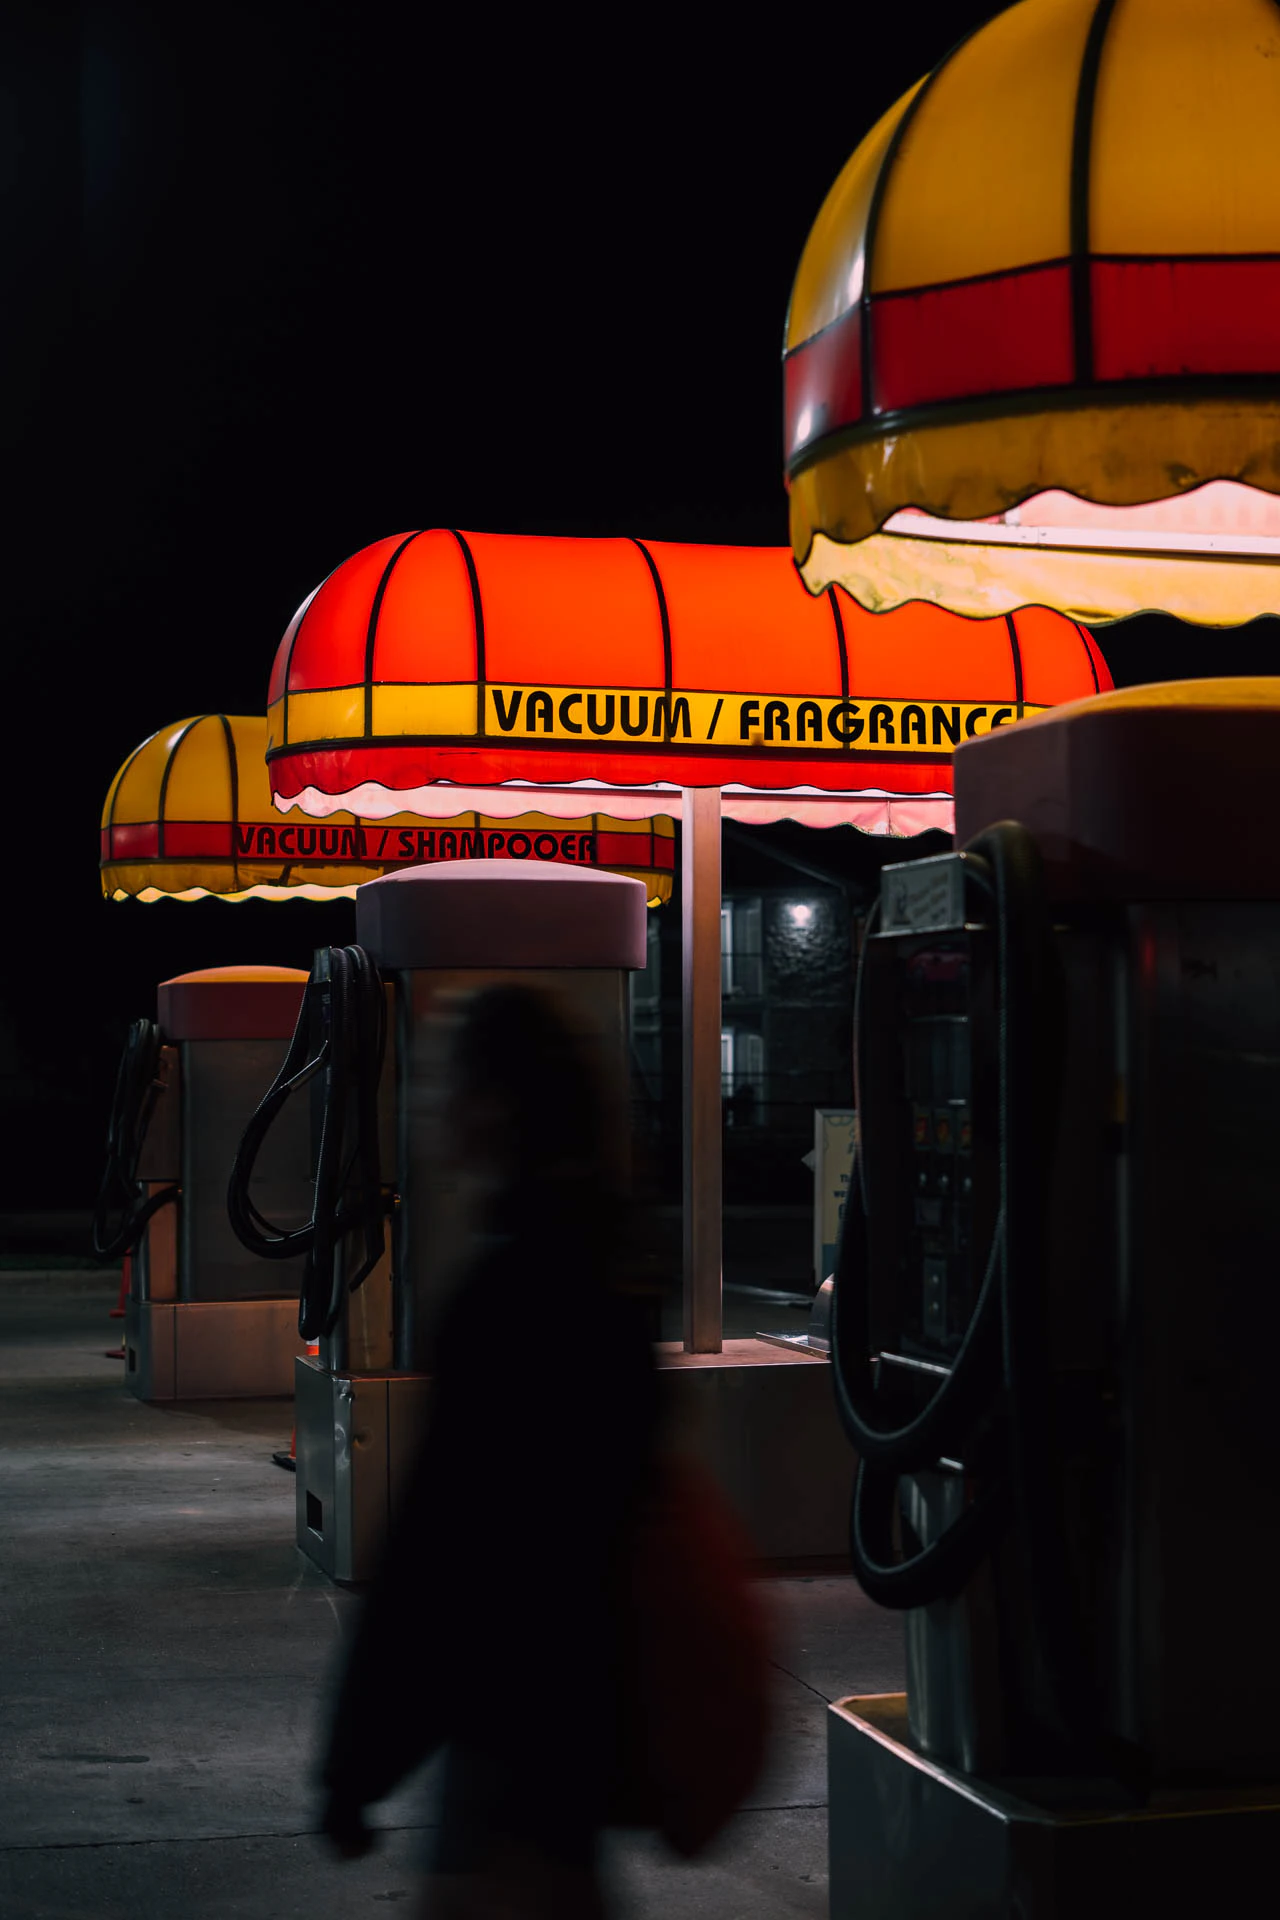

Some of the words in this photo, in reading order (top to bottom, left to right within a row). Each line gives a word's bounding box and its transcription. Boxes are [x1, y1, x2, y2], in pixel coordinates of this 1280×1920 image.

[492, 689, 692, 738] VACUUM
[707, 699, 723, 740] /
[236, 826, 367, 855] VACUUM
[377, 830, 389, 857] /
[399, 831, 596, 861] SHAMPOOER
